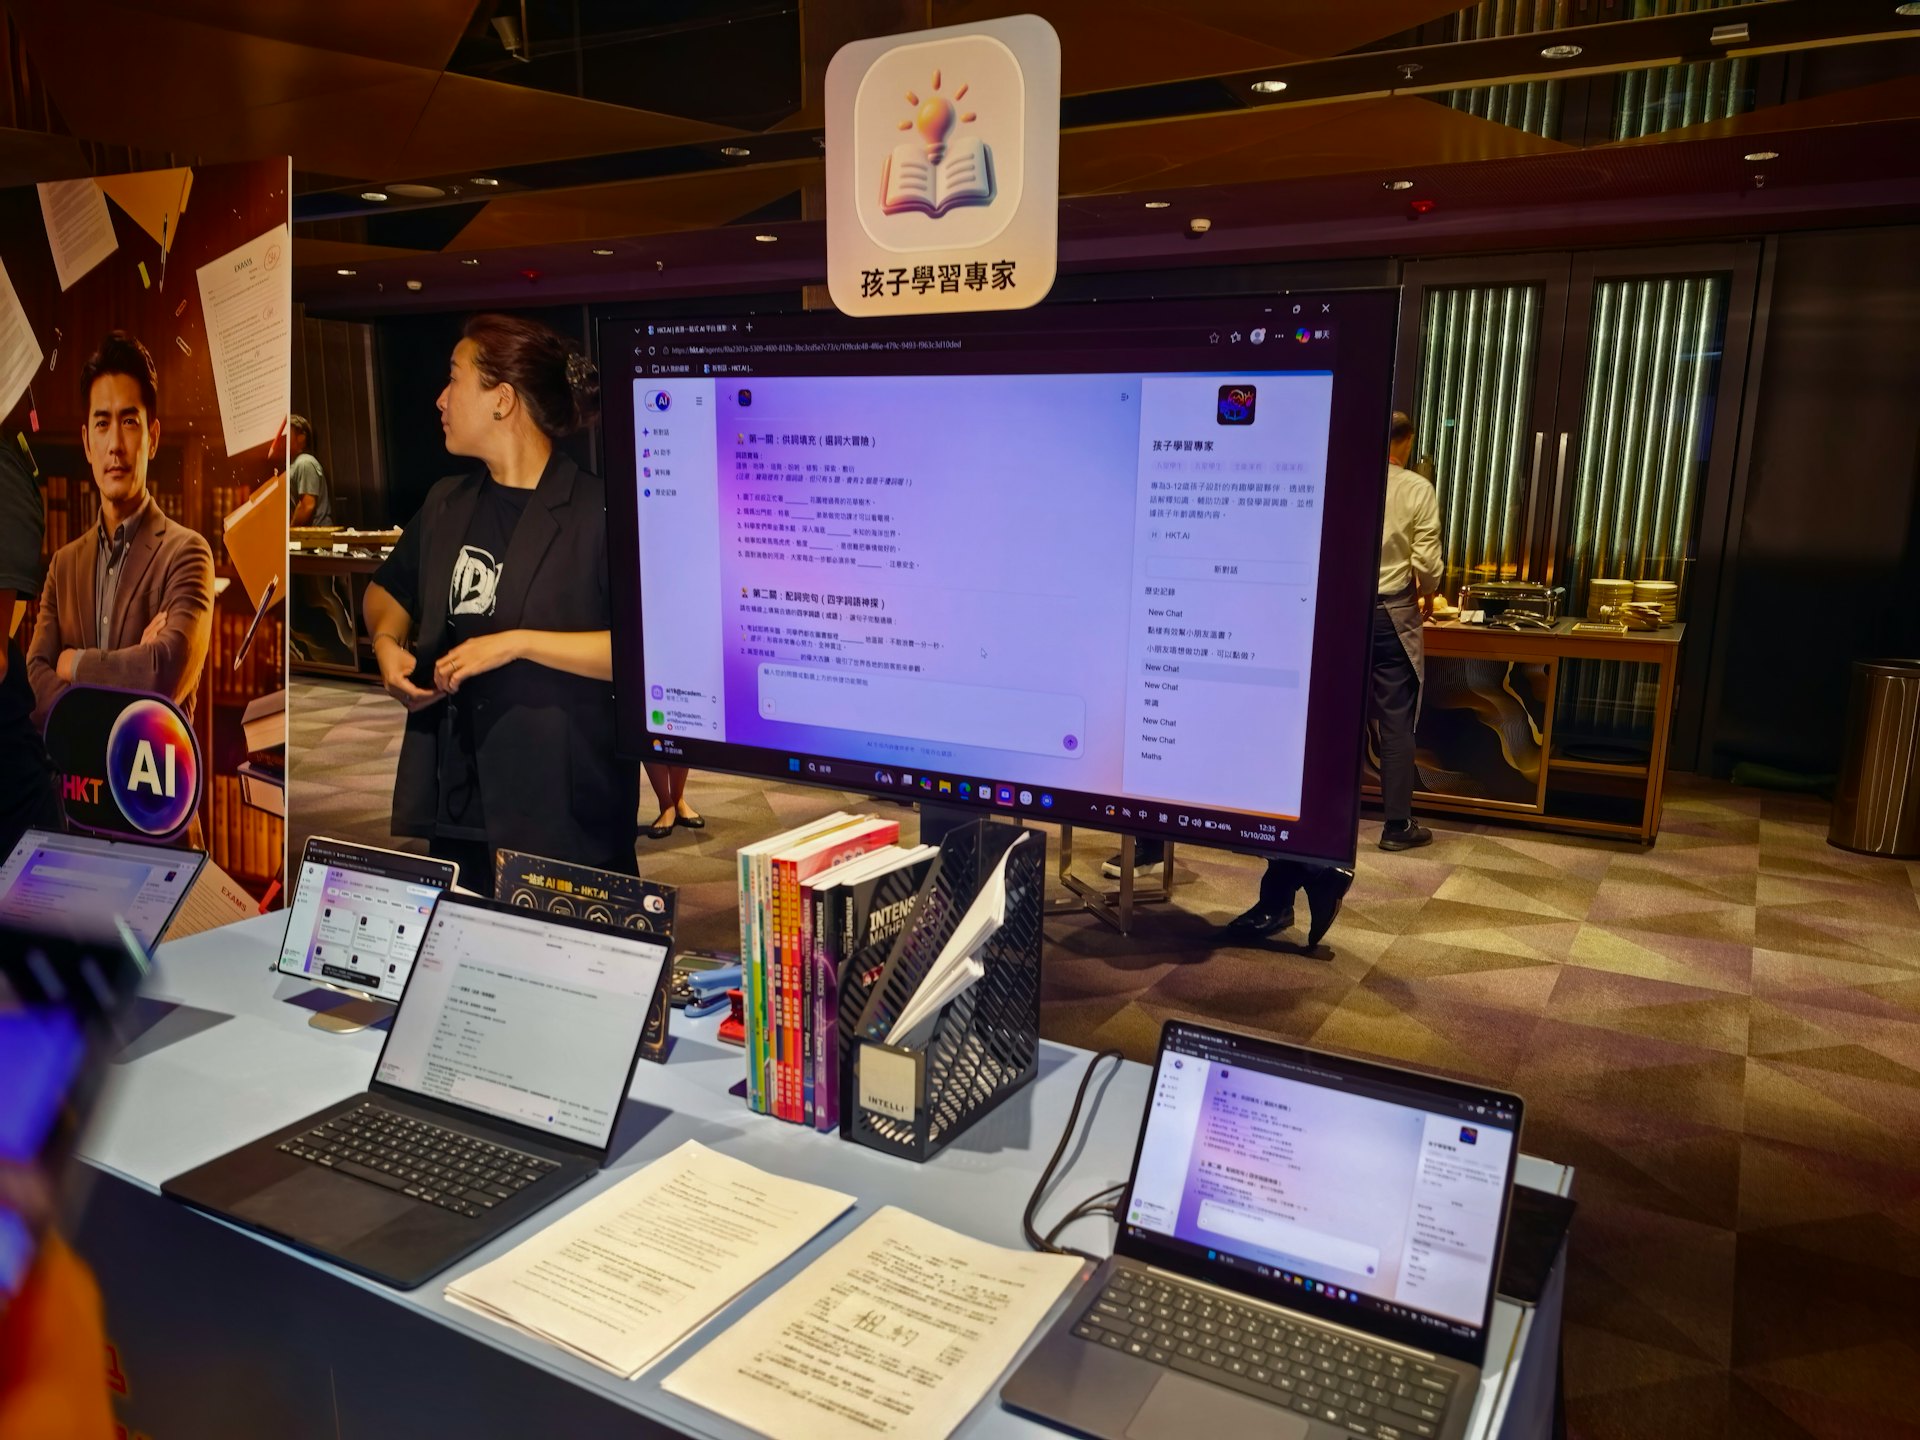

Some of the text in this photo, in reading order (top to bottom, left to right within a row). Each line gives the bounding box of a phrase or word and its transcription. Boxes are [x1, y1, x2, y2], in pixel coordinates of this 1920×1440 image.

[861, 259, 1016, 298] 孩子學習專家
[1152, 440, 1214, 452] 孩子學習專家
[1165, 531, 1190, 539] HKT.AI
[1214, 565, 1238, 575] 新對話
[1148, 609, 1183, 618] New Chat
[1145, 663, 1180, 673] New Chat
[1144, 681, 1179, 691] New Chat
[1143, 717, 1177, 727] New Chat
[1142, 734, 1176, 745] New Chat
[1141, 752, 1162, 761] Maths
[127, 739, 176, 798] AI
[63, 774, 103, 805] HKT
[1139, 810, 1148, 819] 中
[1259, 824, 1277, 833] 12:35
[545, 877, 556, 889] AI
[581, 885, 609, 900] HKT.AI
[221, 886, 247, 912] EXAMS
[869, 896, 918, 932] INTENS
[868, 1096, 904, 1113] INTELLI
